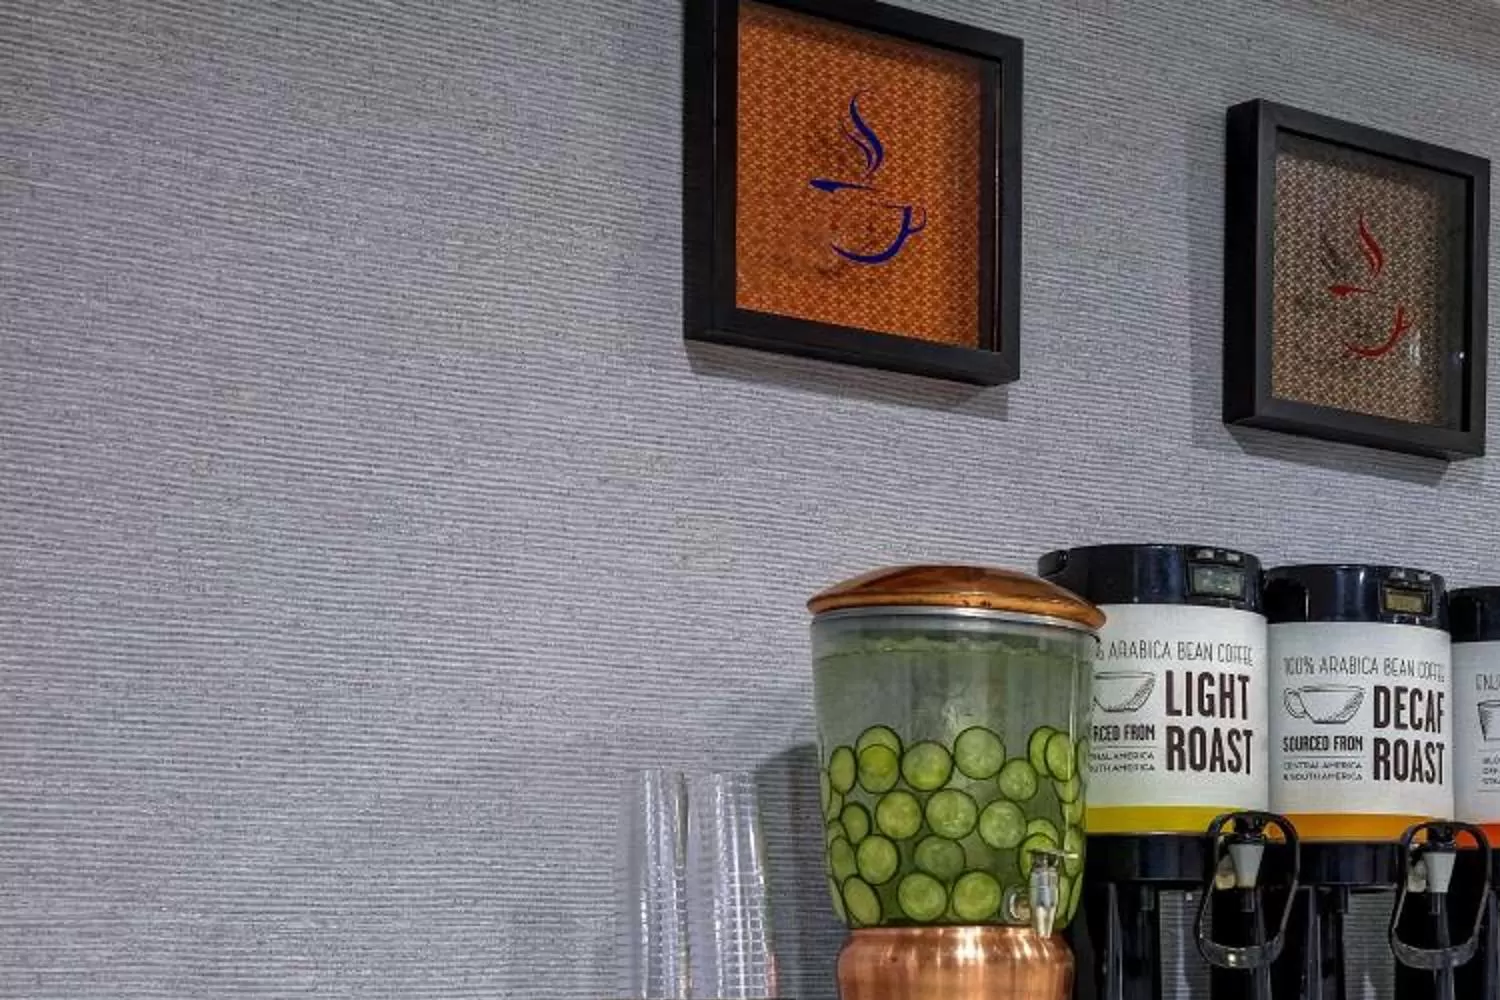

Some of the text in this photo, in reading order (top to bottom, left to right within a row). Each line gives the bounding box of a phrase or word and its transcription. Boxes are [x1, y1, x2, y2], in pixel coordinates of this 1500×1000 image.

[1108, 639, 1173, 661] ARABICA
[1177, 641, 1213, 662] BEAN
[1319, 655, 1379, 675] ARABICA
[1383, 656, 1415, 676] BEAN
[1165, 669, 1250, 720] LIGHT
[1373, 685, 1445, 735] DECAF
[1091, 723, 1155, 742] RCED FROM
[1165, 725, 1253, 774] ROAST
[1283, 735, 1363, 752] SOURCED FROM
[1373, 737, 1445, 785] ROAST
